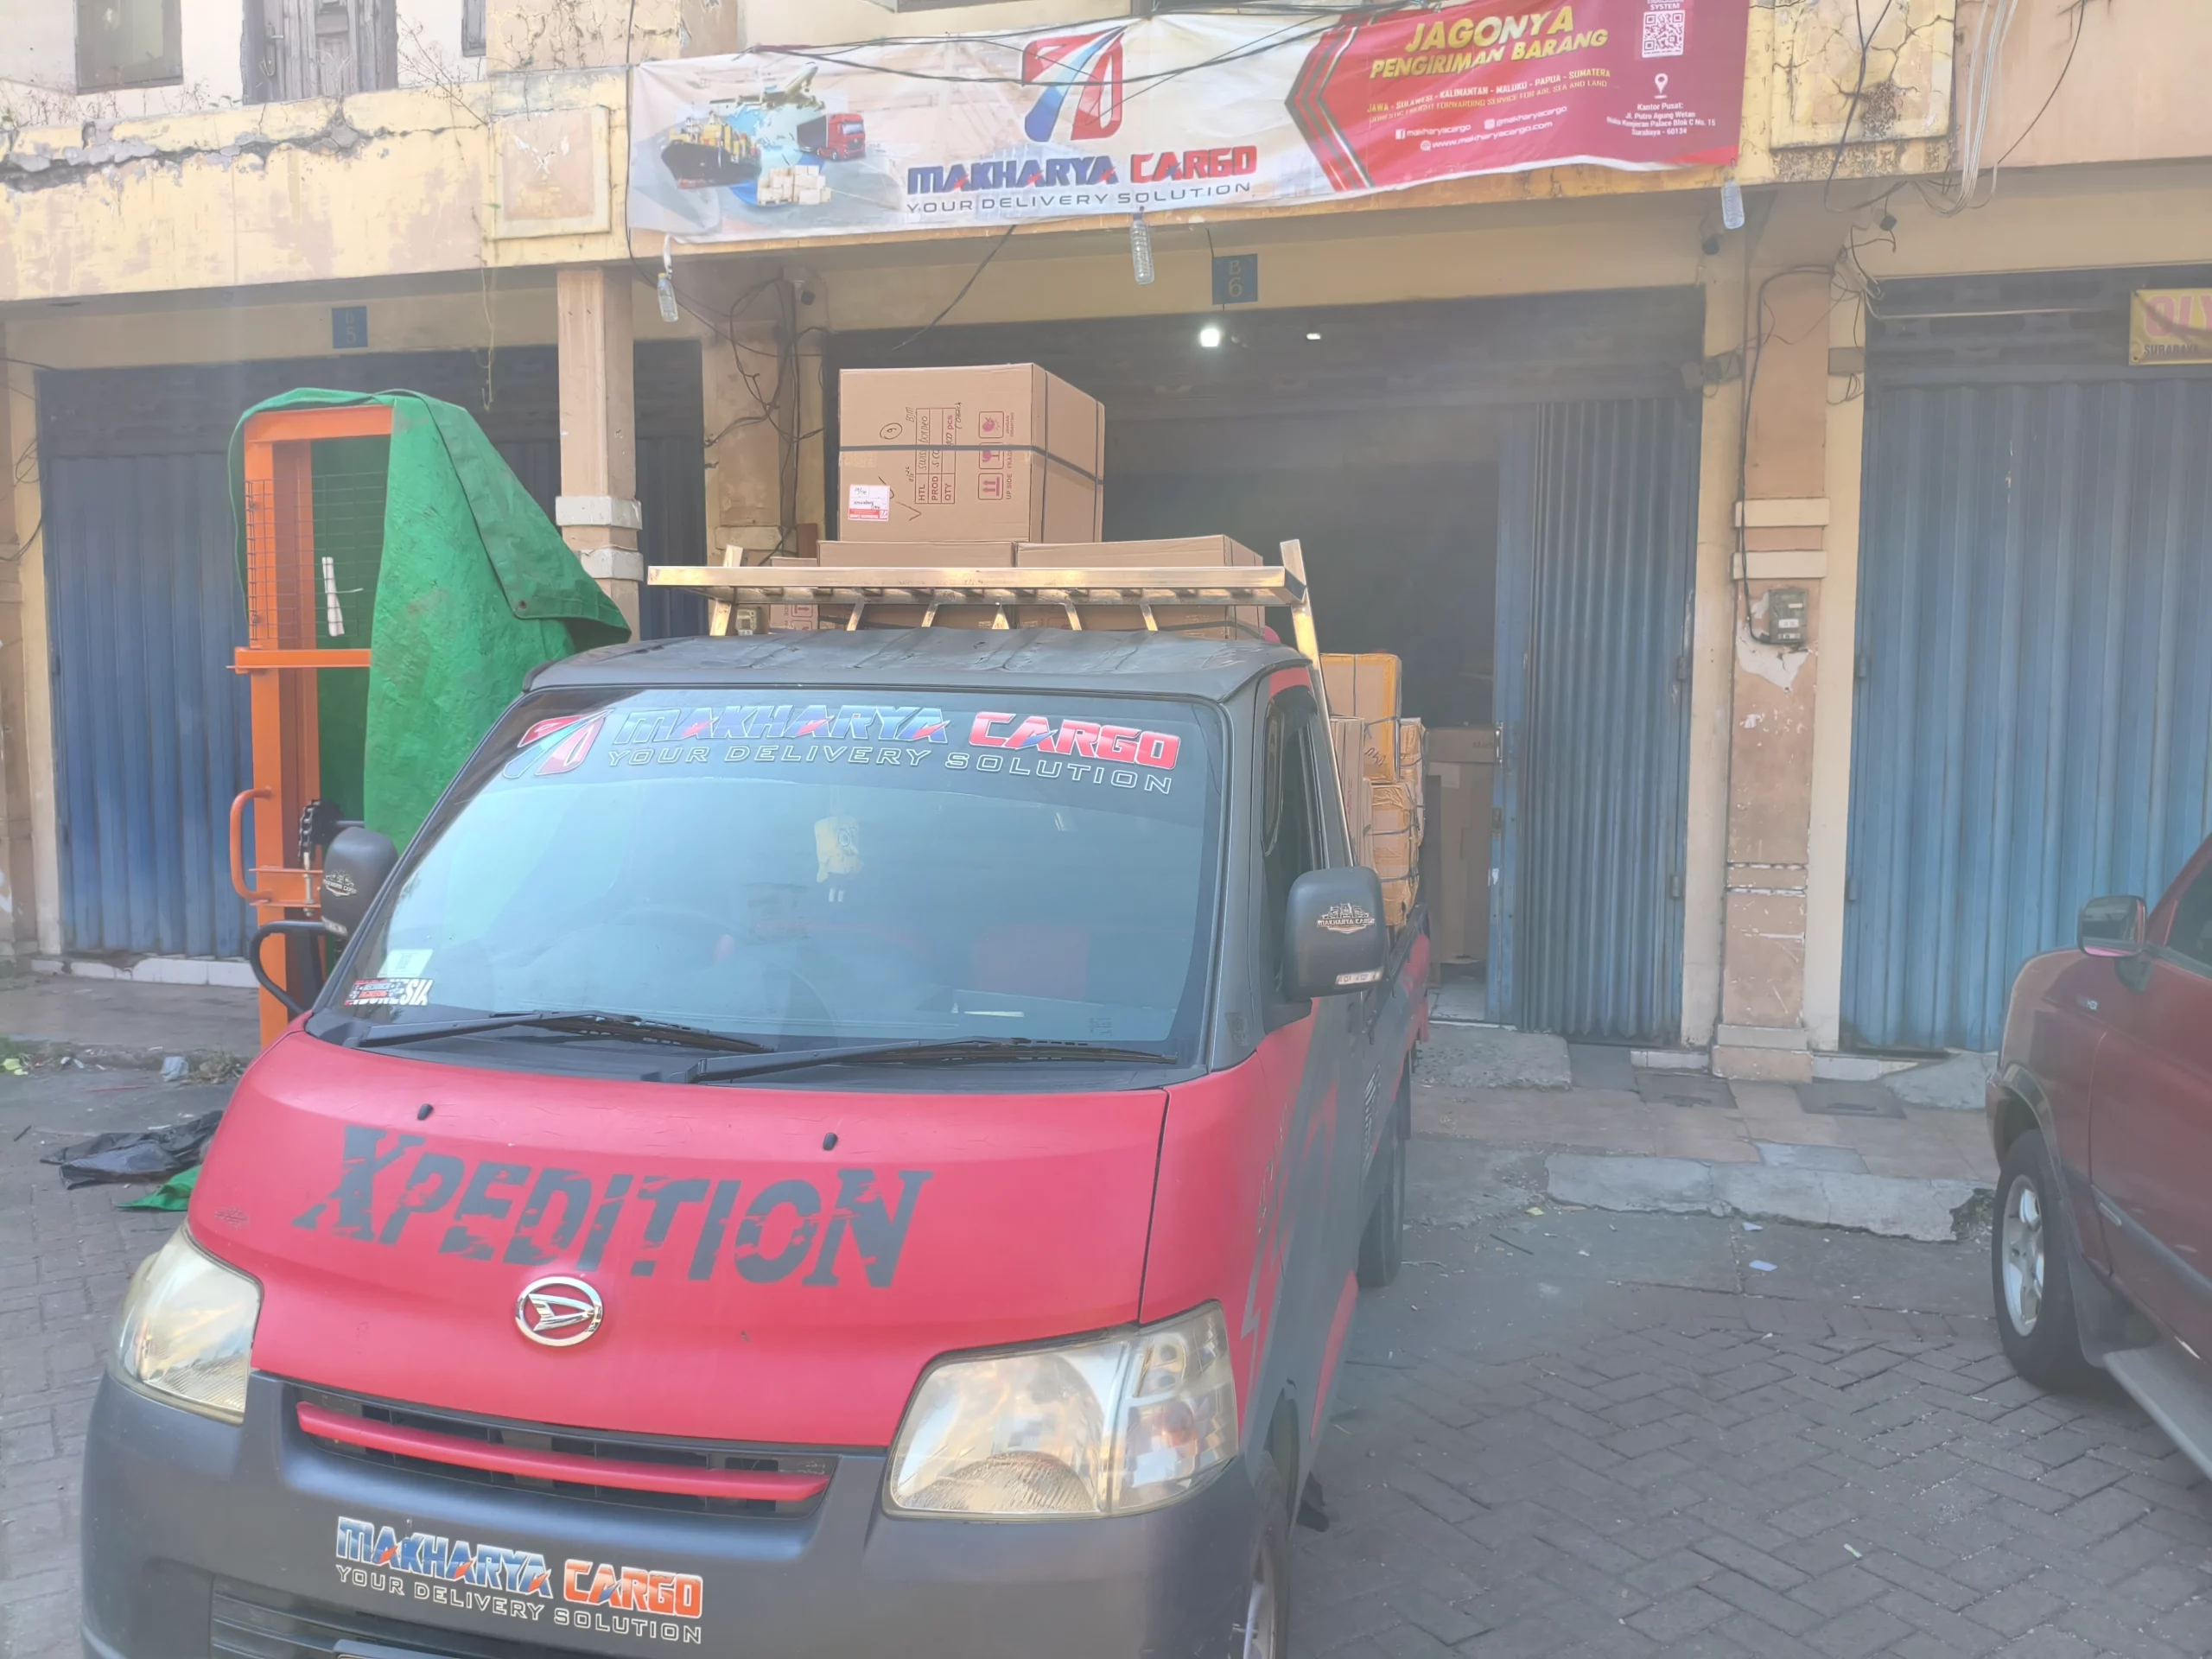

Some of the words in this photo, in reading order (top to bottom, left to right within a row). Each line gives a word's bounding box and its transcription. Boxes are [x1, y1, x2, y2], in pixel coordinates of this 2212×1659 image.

[1405, 6, 1574, 53] JAGONYA
[1370, 46, 1505, 79] PENGIRIMAN
[1511, 29, 1608, 60] BARANG
[1367, 103, 1389, 113] JAWA
[1440, 86, 1488, 99] KALIMANTAN
[1496, 81, 1528, 94] MALUKU
[1535, 74, 1561, 86] PAPUA
[1568, 68, 1611, 79] SUMATERA
[1637, 103, 1661, 111] Kantor
[1407, 124, 1471, 137] makharyacargo
[1631, 128, 1661, 137] Surabaya
[1653, 112, 1675, 121] Agung
[906, 155, 1119, 195] MAKHARYA
[1130, 145, 1257, 183] CARGO
[906, 200, 973, 213] YOUR
[982, 194, 1109, 210] DELIVERY
[1117, 181, 1251, 204] SOLUTION
[1228, 276, 1243, 298] 6
[1006, 490, 1012, 499] UP
[613, 704, 951, 745] MAKHARYA
[968, 710, 1181, 771] CARGO
[608, 746, 711, 767] YOUR
[723, 744, 932, 766] DELIVERY
[944, 752, 1173, 796] SOLUTION
[290, 1124, 936, 1288] XPEDITION
[335, 1515, 554, 1599] MAKHARYA
[563, 1558, 703, 1619] CARGO
[335, 1564, 405, 1597] YOUR
[413, 1581, 545, 1621] DELIVERY
[553, 1606, 702, 1645] SOLUTION
